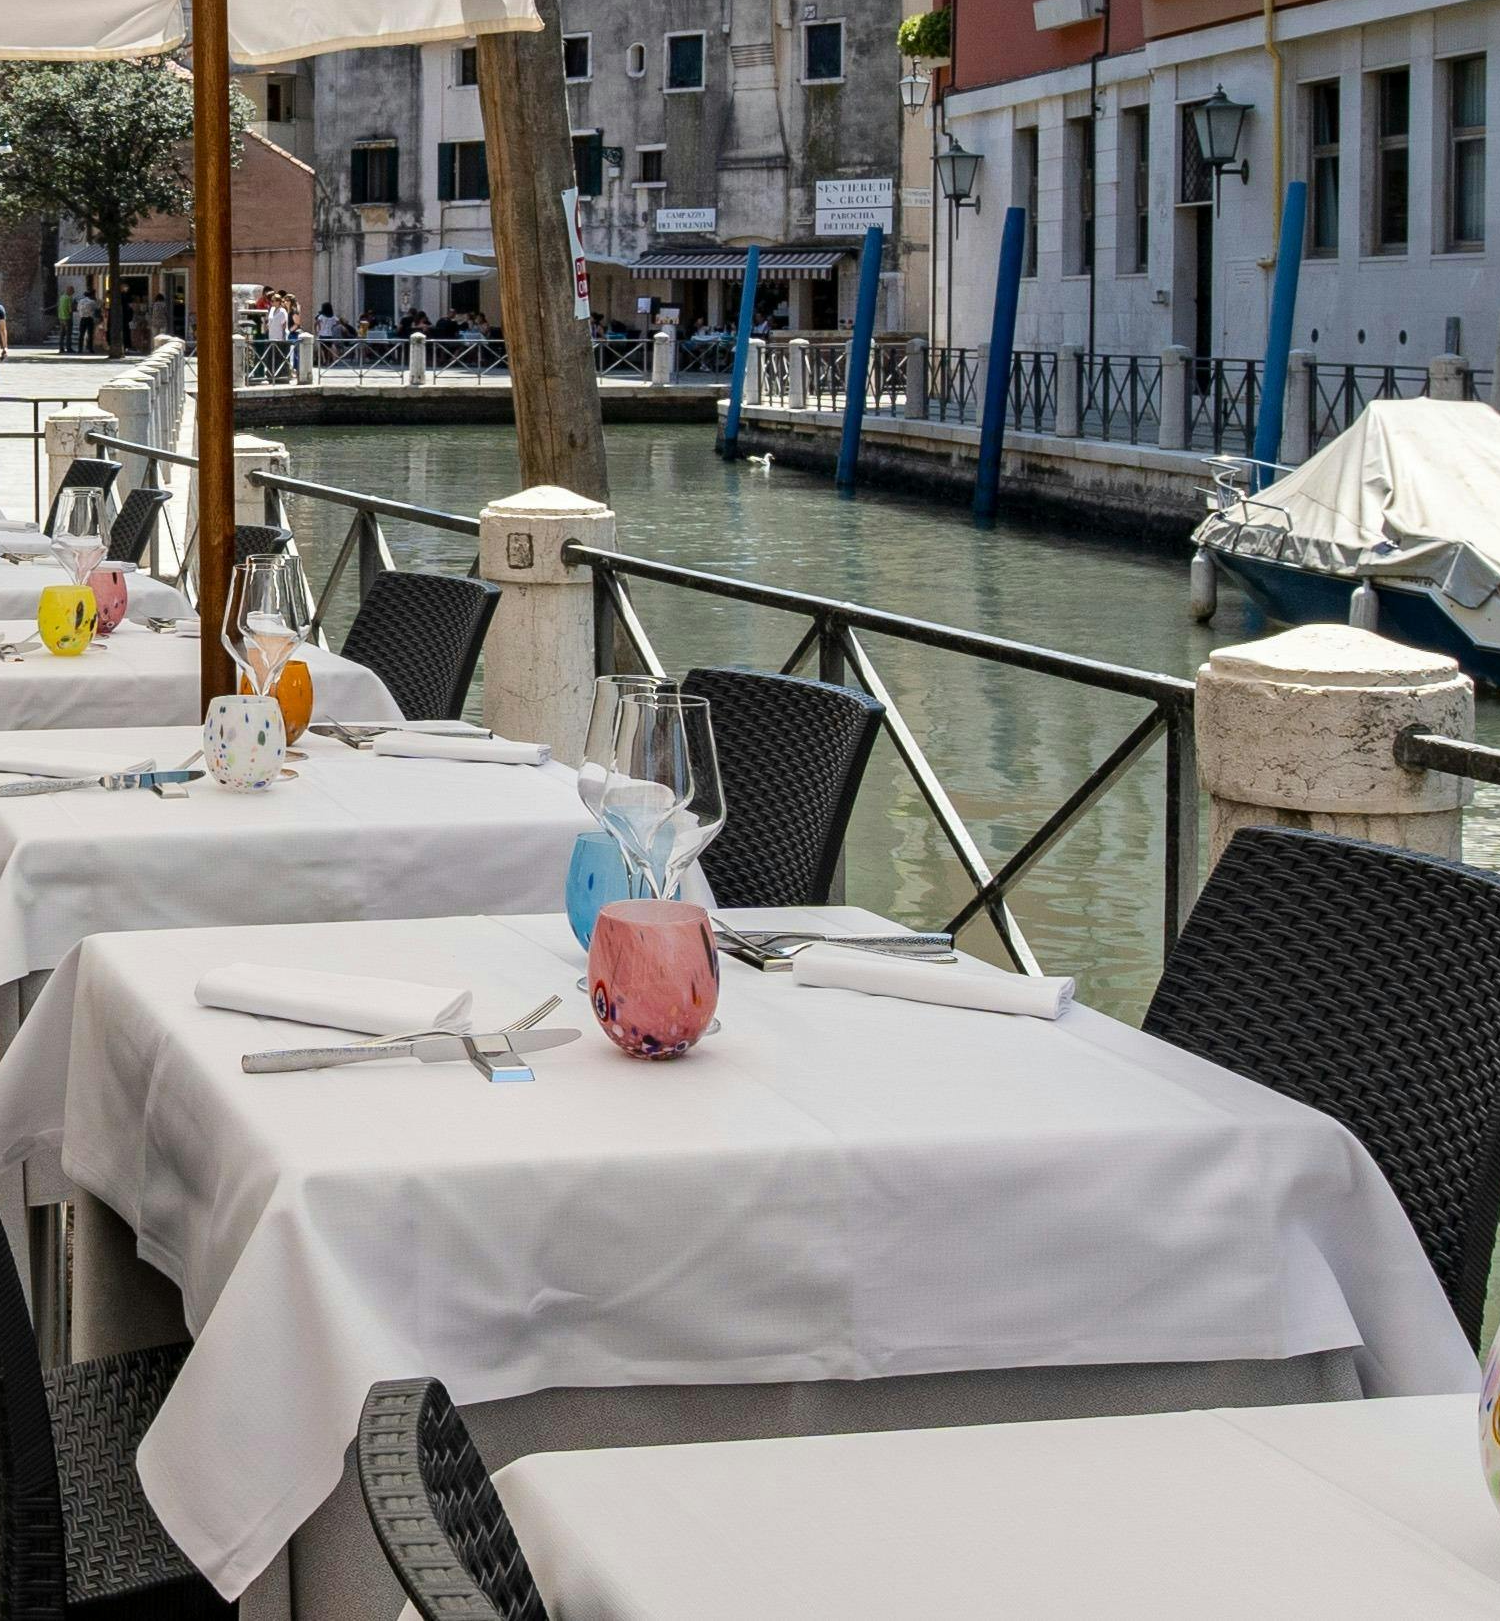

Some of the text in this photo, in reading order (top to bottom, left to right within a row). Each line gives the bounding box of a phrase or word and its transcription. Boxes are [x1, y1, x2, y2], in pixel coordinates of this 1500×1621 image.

[817, 182, 891, 193] SESTIERE DI
[839, 194, 881, 205] CROCE
[830, 211, 875, 220] PAROCHIA
